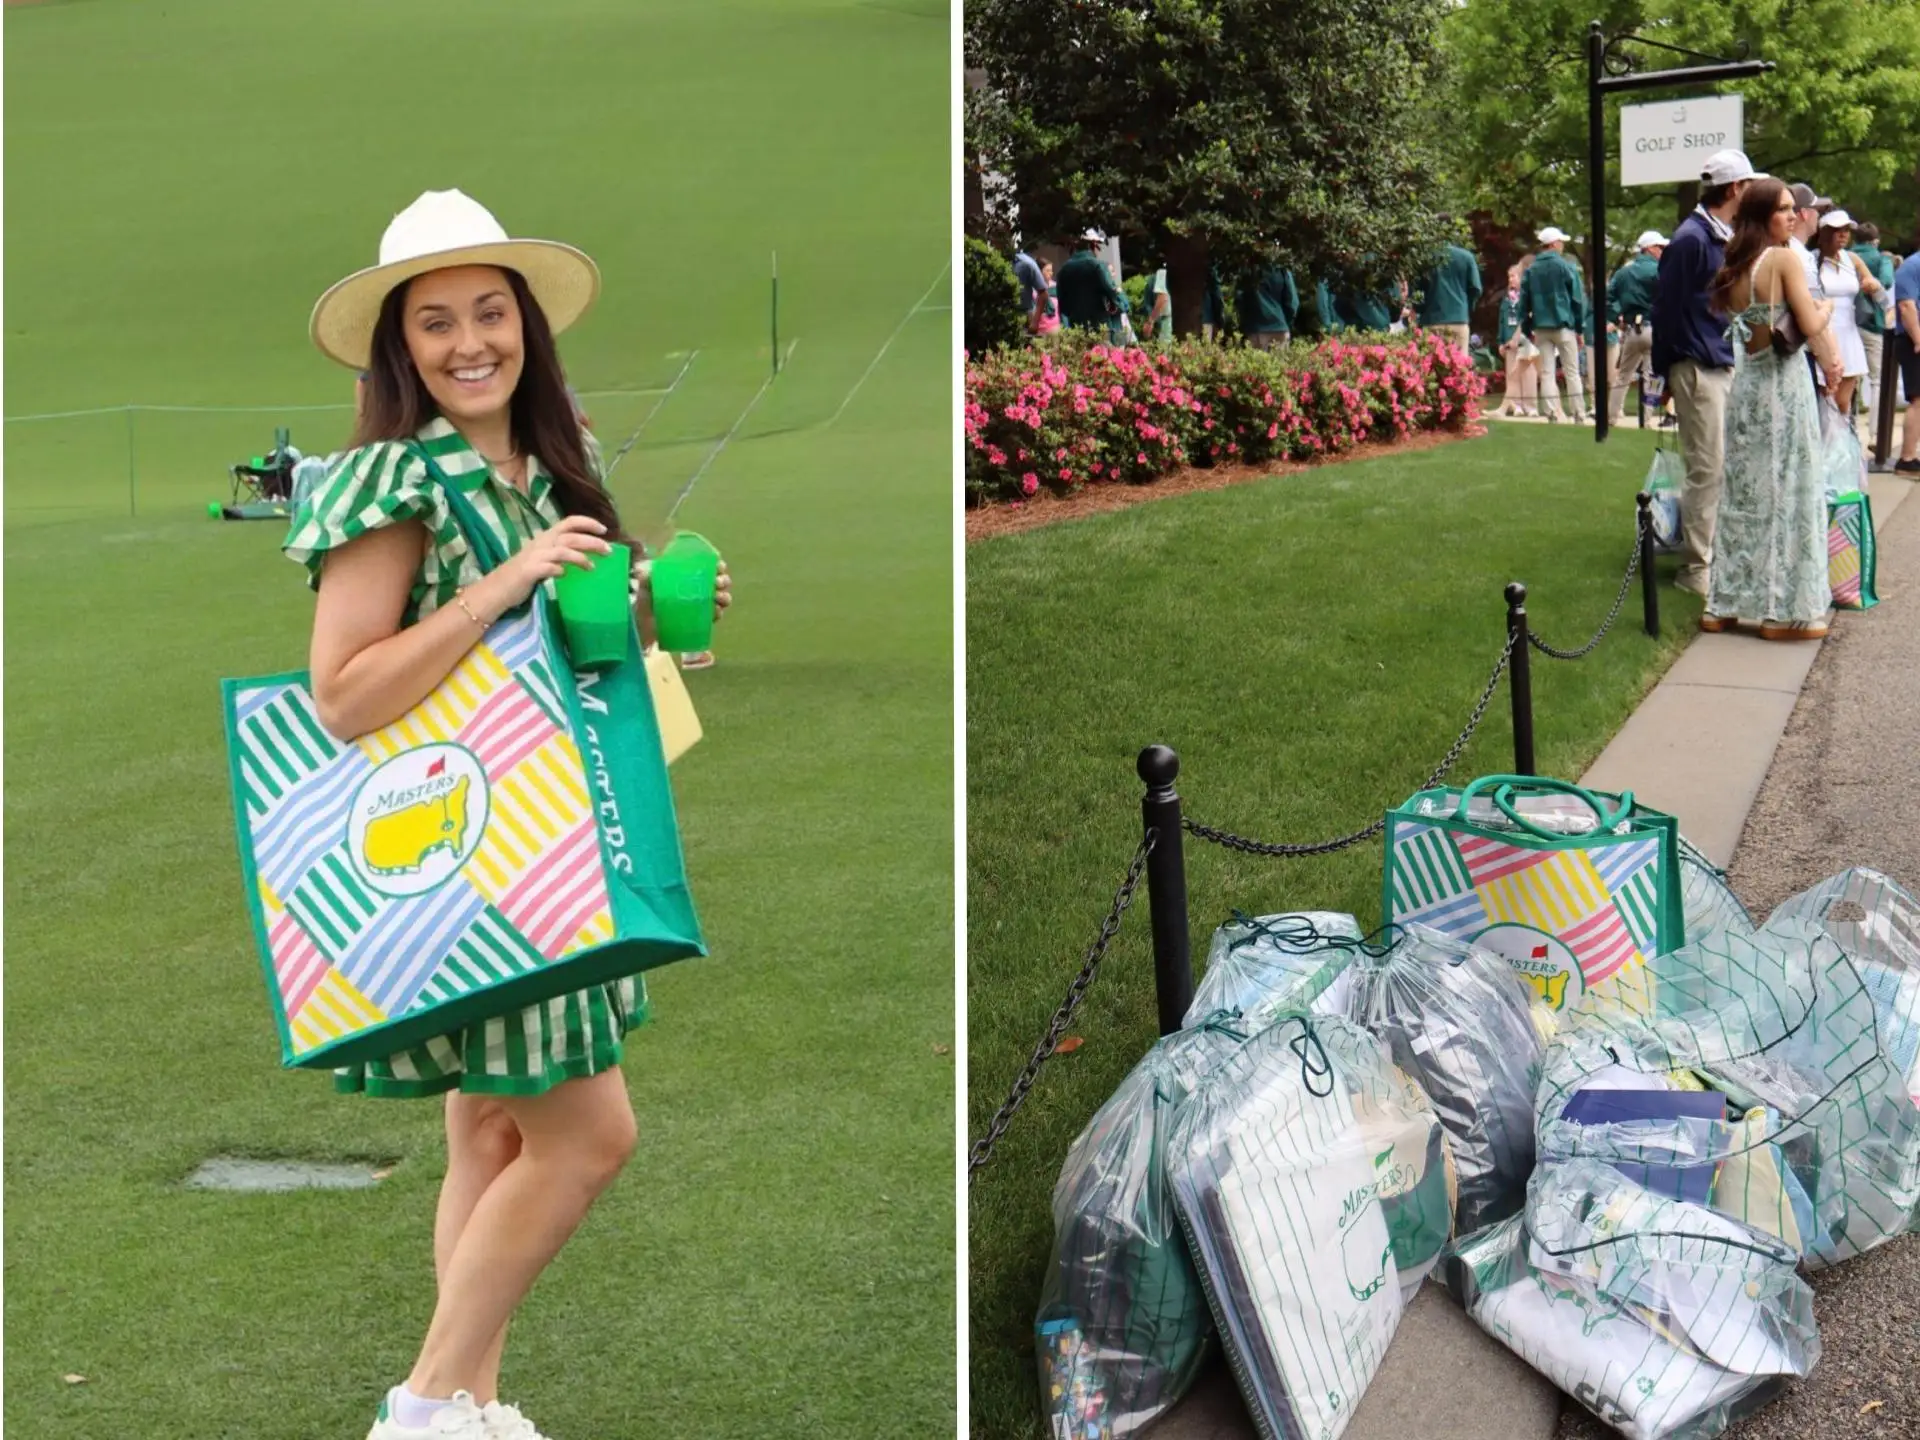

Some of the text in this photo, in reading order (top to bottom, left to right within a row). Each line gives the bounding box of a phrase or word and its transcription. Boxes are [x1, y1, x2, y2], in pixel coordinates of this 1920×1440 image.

[1635, 132, 1726, 153] GOLF SHOP
[367, 774, 455, 815] MASTERS
[1499, 952, 1558, 974] ASTERS
[1338, 1163, 1403, 1228] MASTERS
